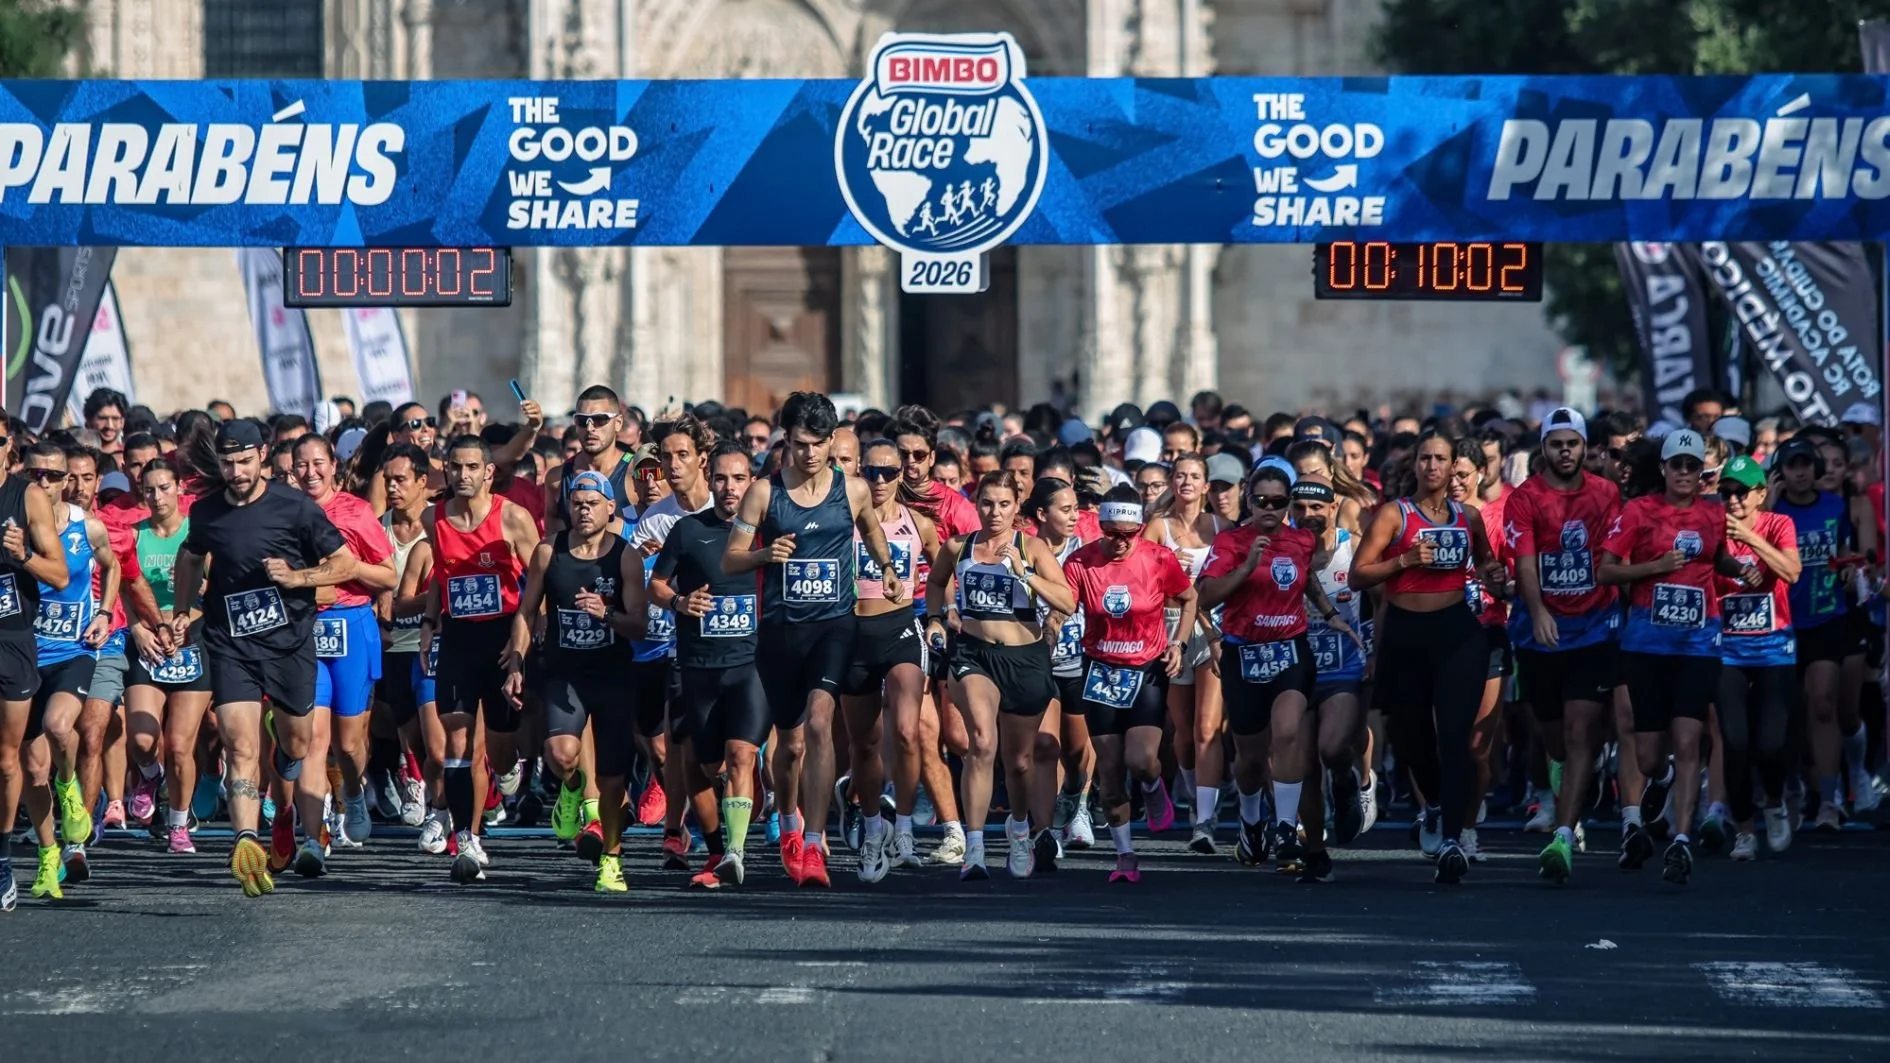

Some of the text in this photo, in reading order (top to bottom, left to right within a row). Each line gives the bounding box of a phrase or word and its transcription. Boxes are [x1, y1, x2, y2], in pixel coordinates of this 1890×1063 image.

[889, 58, 998, 82] BIMBO
[508, 97, 560, 123] THE
[890, 98, 996, 136] Global
[1253, 93, 1306, 120] THE
[0, 99, 405, 206] PARABÉNS
[508, 126, 638, 162] GOOD
[866, 131, 954, 169] Race
[1253, 123, 1384, 159] GOOD
[1487, 92, 1890, 200] PARABÉNS
[508, 170, 552, 197] WE
[1253, 167, 1299, 194] WE
[507, 199, 639, 230] SHARE
[1252, 196, 1386, 226] SHARE
[299, 248, 495, 297] 00:00:02
[909, 261, 973, 286] 2026
[1330, 241, 1527, 291] 00:10:02
[64, 246, 93, 312] SPORTS
[791, 580, 833, 594] 4098
[1548, 568, 1587, 583] 4409
[454, 592, 493, 609] 4454
[969, 589, 1007, 606] 4065
[33, 616, 72, 633] 4476
[237, 605, 278, 628] 4124
[709, 614, 750, 629] 4349
[1659, 604, 1698, 621] 4230
[1729, 612, 1767, 627] 4246
[566, 628, 606, 643] 4229
[1097, 639, 1144, 653] SANTIAGO
[159, 665, 196, 680] 4292
[1249, 660, 1289, 677] 4458
